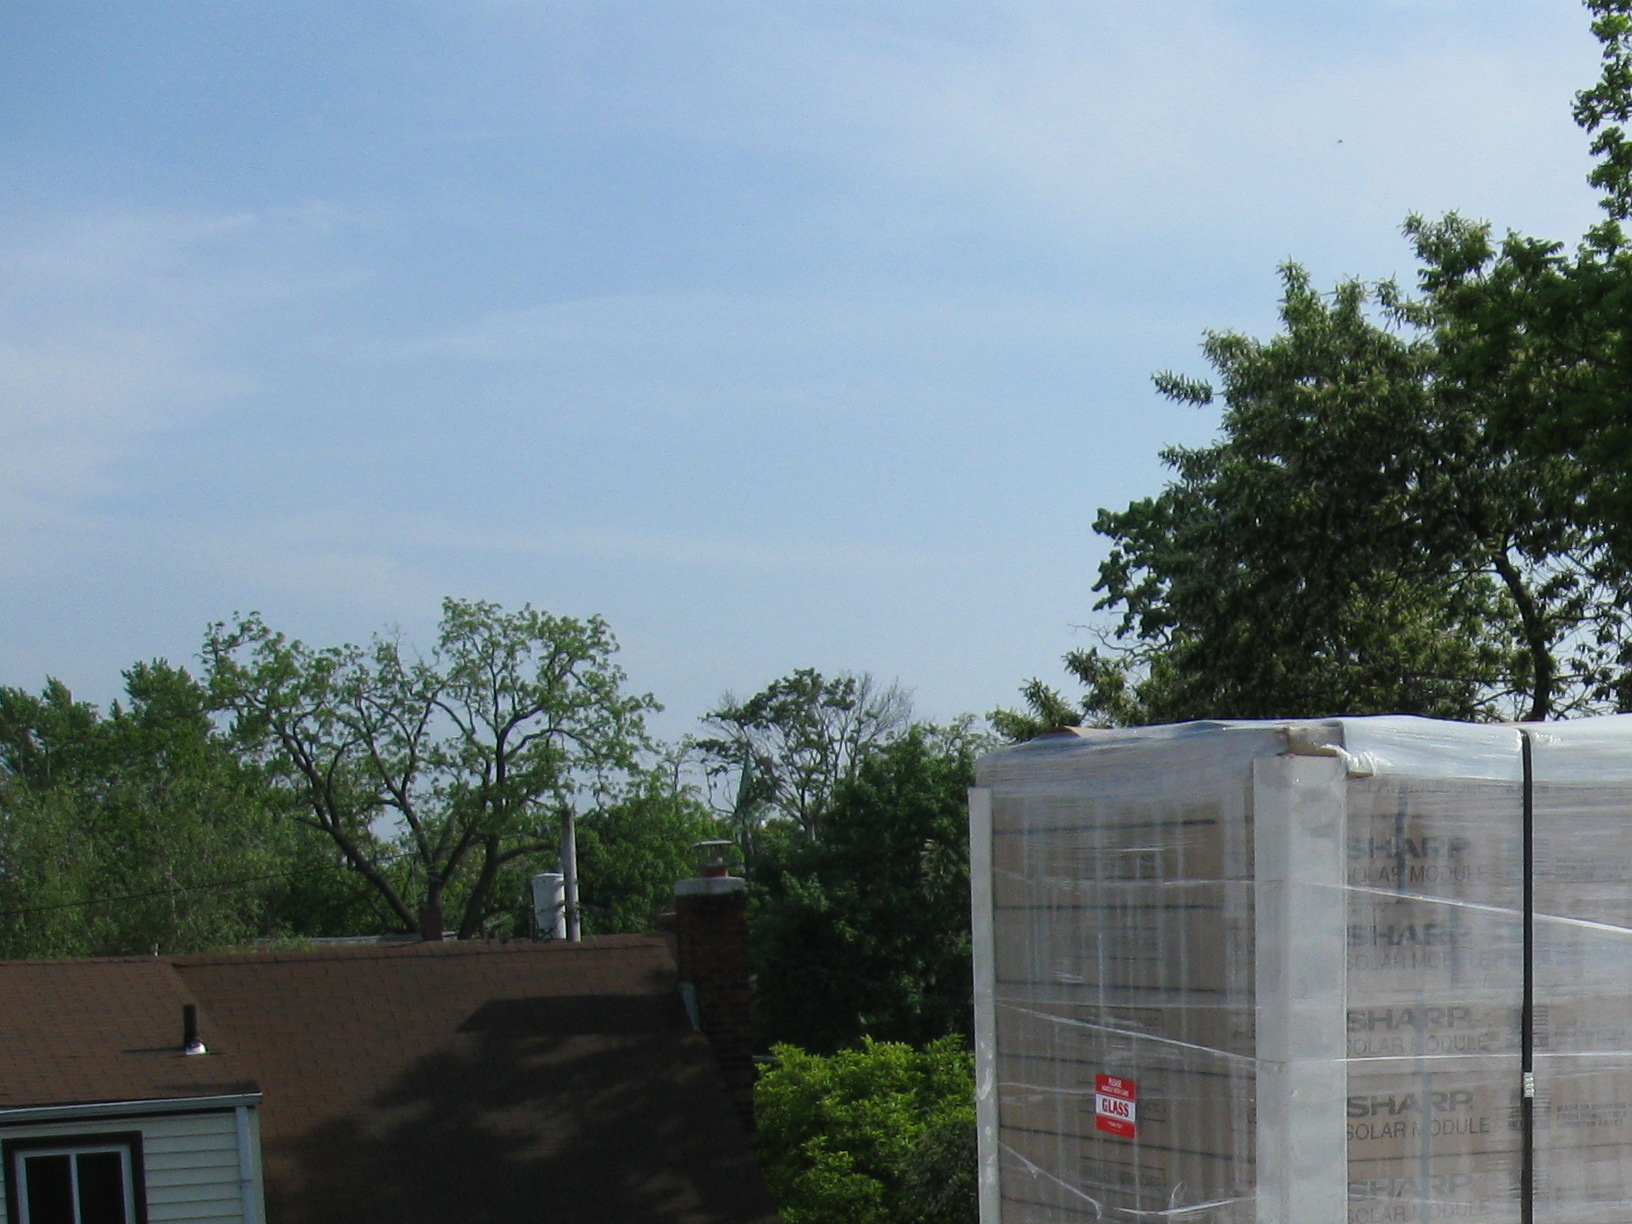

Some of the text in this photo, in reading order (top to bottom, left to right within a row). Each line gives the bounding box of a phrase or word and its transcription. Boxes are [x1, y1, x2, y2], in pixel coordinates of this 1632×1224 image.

[1347, 837, 1471, 860] SHARP
[1347, 923, 1471, 947] SHARP
[1347, 1005, 1472, 1032] SHARP
[1413, 1033, 1487, 1051] ODULE
[1102, 1098, 1129, 1117] GLASS
[1347, 1091, 1474, 1117] SHARP
[1347, 1120, 1407, 1140] SOLAR
[1347, 1174, 1473, 1202] SHARP
[1413, 1201, 1490, 1221] ODULE
